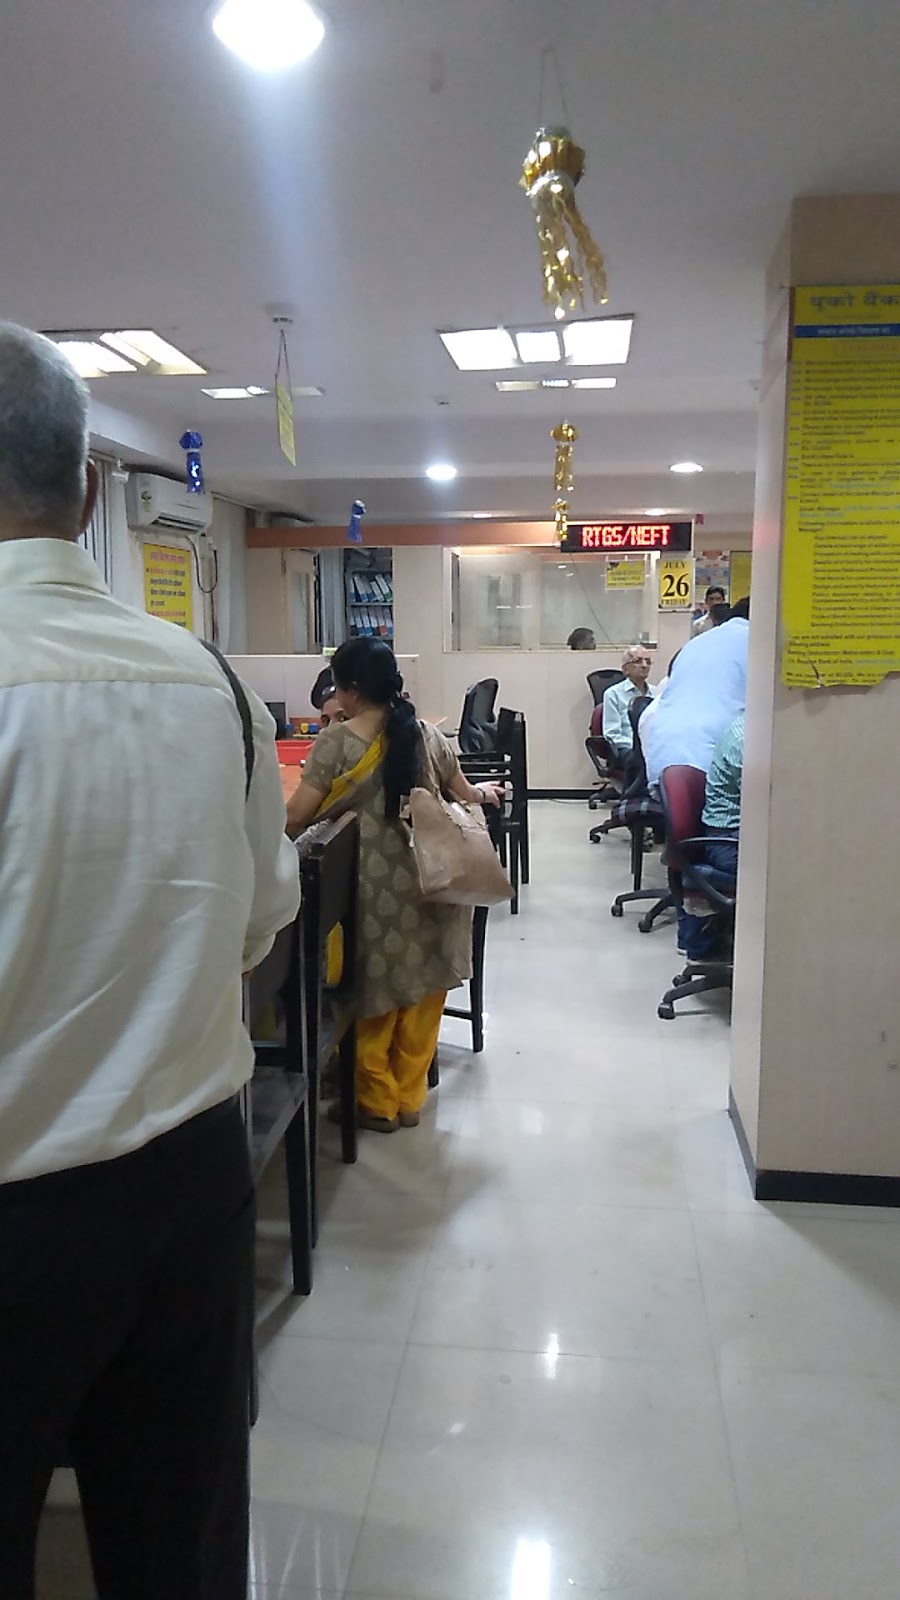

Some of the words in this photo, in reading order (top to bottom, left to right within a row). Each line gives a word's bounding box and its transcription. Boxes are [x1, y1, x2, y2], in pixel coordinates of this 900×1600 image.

[582, 525, 670, 547] RTGS/NEFT
[665, 561, 686, 569] JULY
[663, 573, 690, 597] 26
